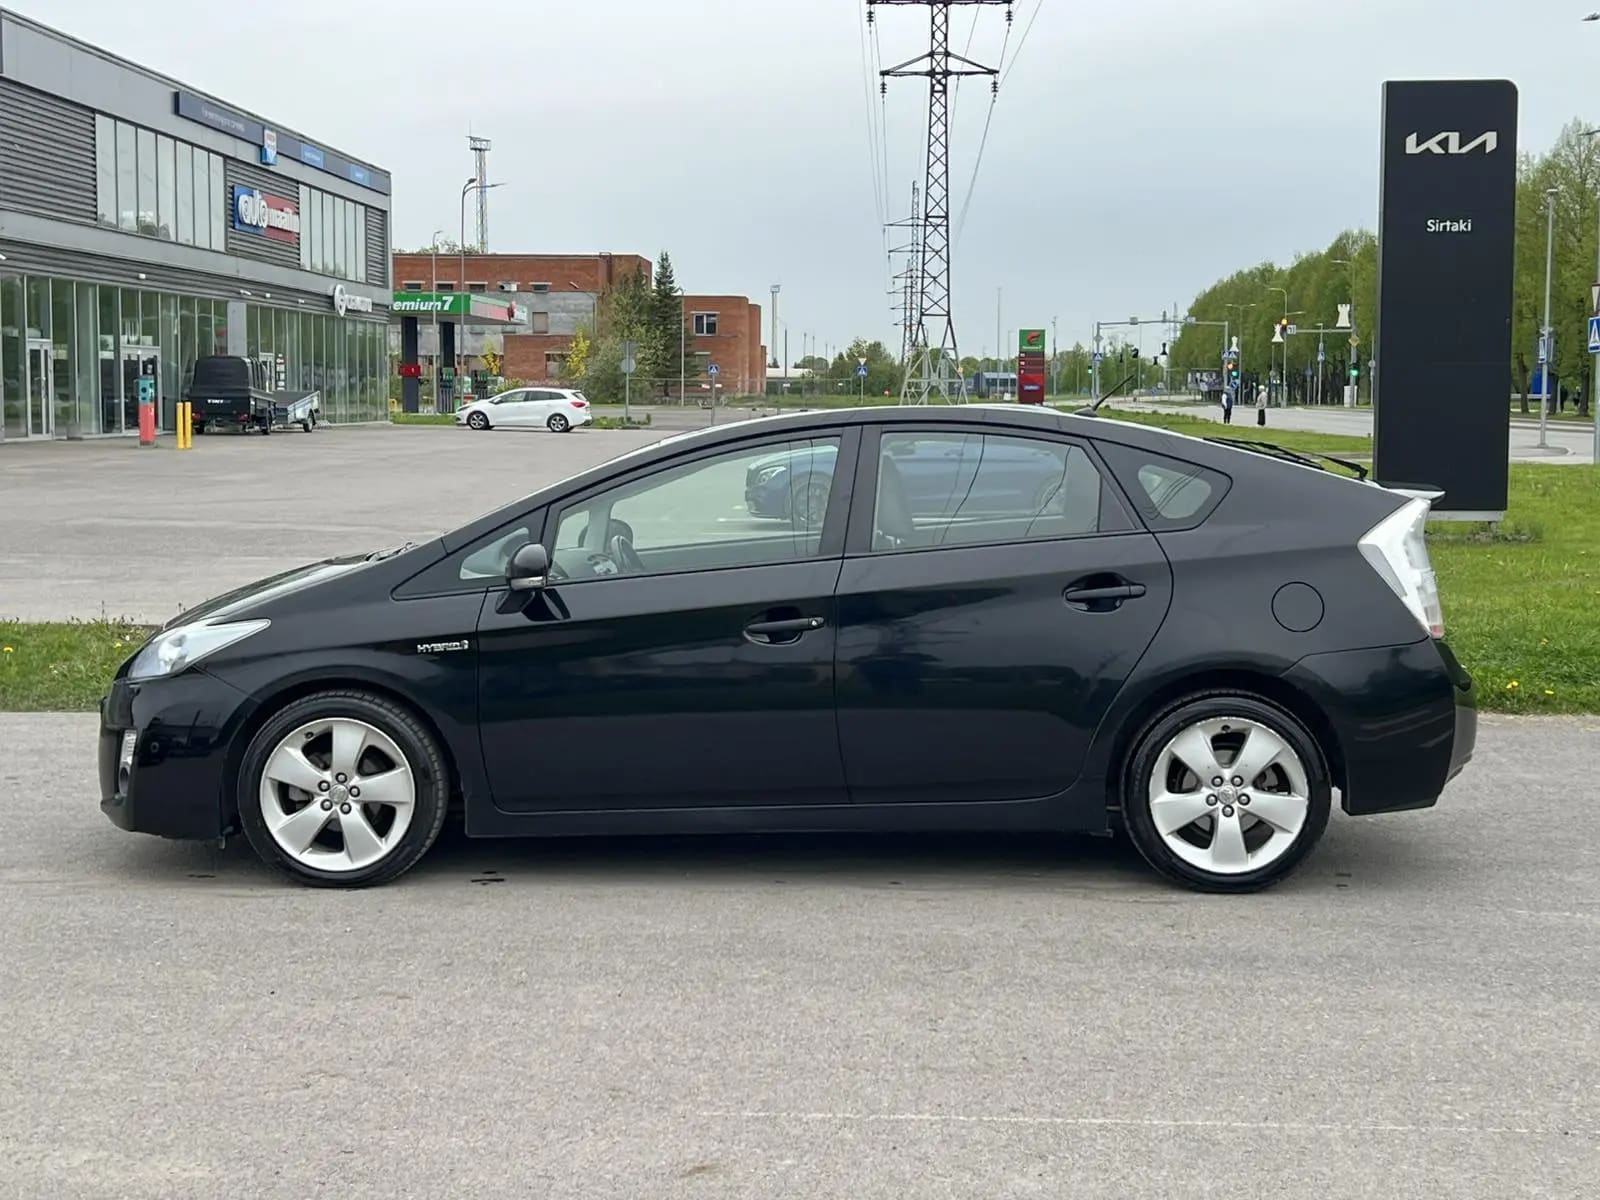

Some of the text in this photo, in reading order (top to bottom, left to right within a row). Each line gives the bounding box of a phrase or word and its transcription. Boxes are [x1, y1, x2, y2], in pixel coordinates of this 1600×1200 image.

[1405, 131, 1497, 154] KIA
[1426, 219, 1472, 232] Sirtaki
[389, 295, 454, 311] emium7
[416, 642, 463, 653] HYBRID
